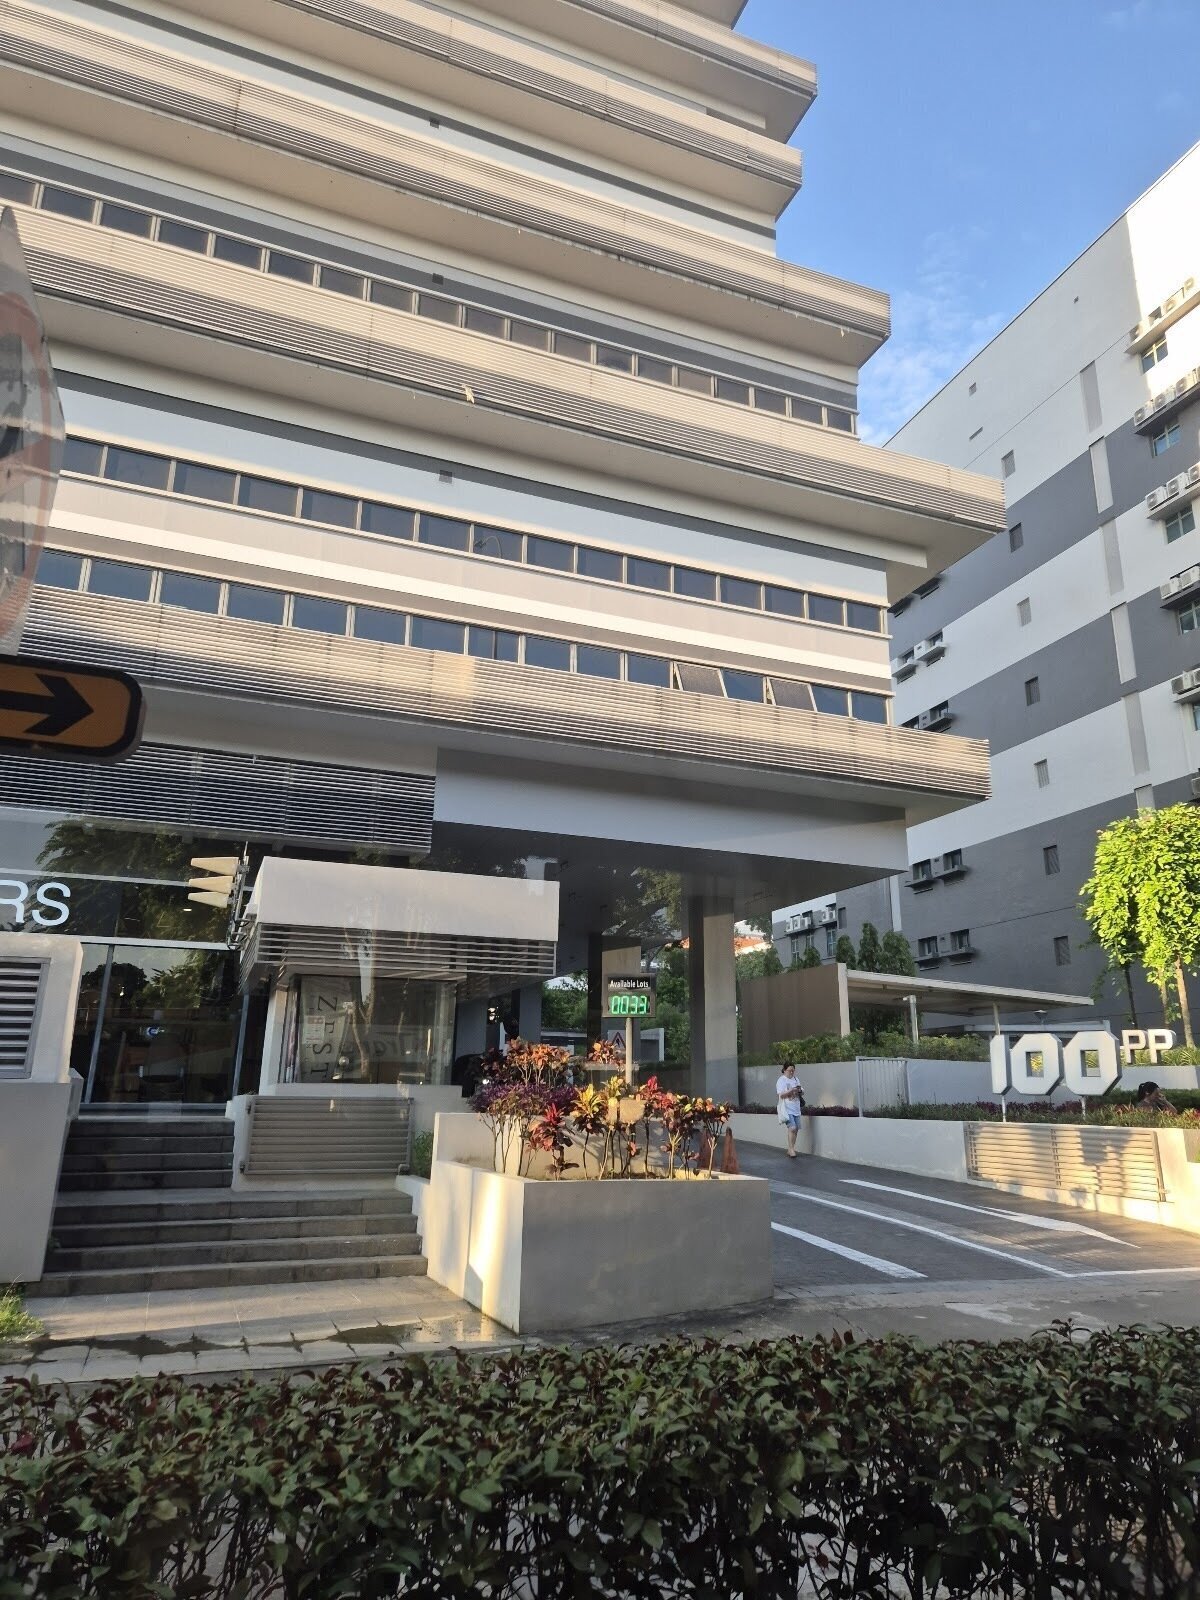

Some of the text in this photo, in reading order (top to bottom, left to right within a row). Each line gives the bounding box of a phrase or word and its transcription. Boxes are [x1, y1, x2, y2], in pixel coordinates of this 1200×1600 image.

[0, 880, 71, 926] RS
[610, 980, 649, 988] Available Lots
[611, 995, 647, 1014] 0033
[990, 1028, 1177, 1096] 100 PP
